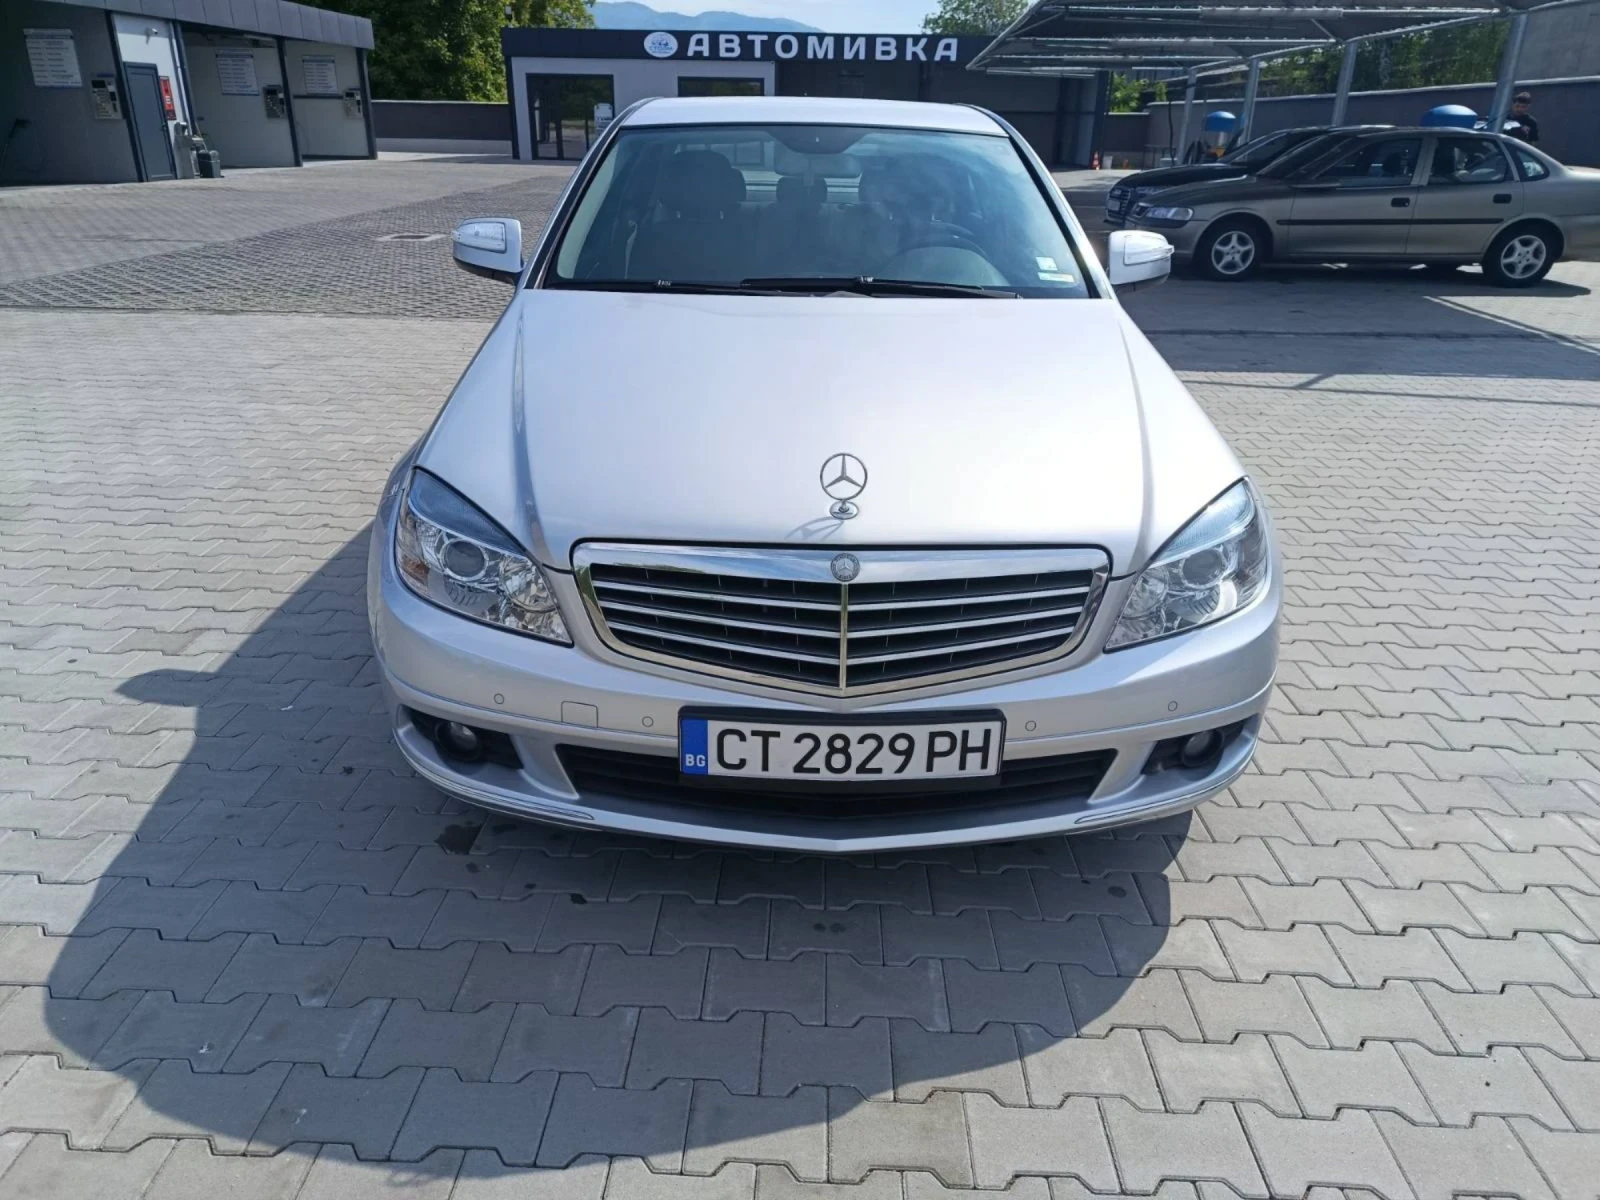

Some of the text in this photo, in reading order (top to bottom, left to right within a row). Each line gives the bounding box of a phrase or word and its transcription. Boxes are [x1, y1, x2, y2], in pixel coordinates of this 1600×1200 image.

[688, 33, 958, 61] АВТОМИВКА
[685, 754, 706, 767] BG
[717, 728, 991, 774] CT 2829 PH
